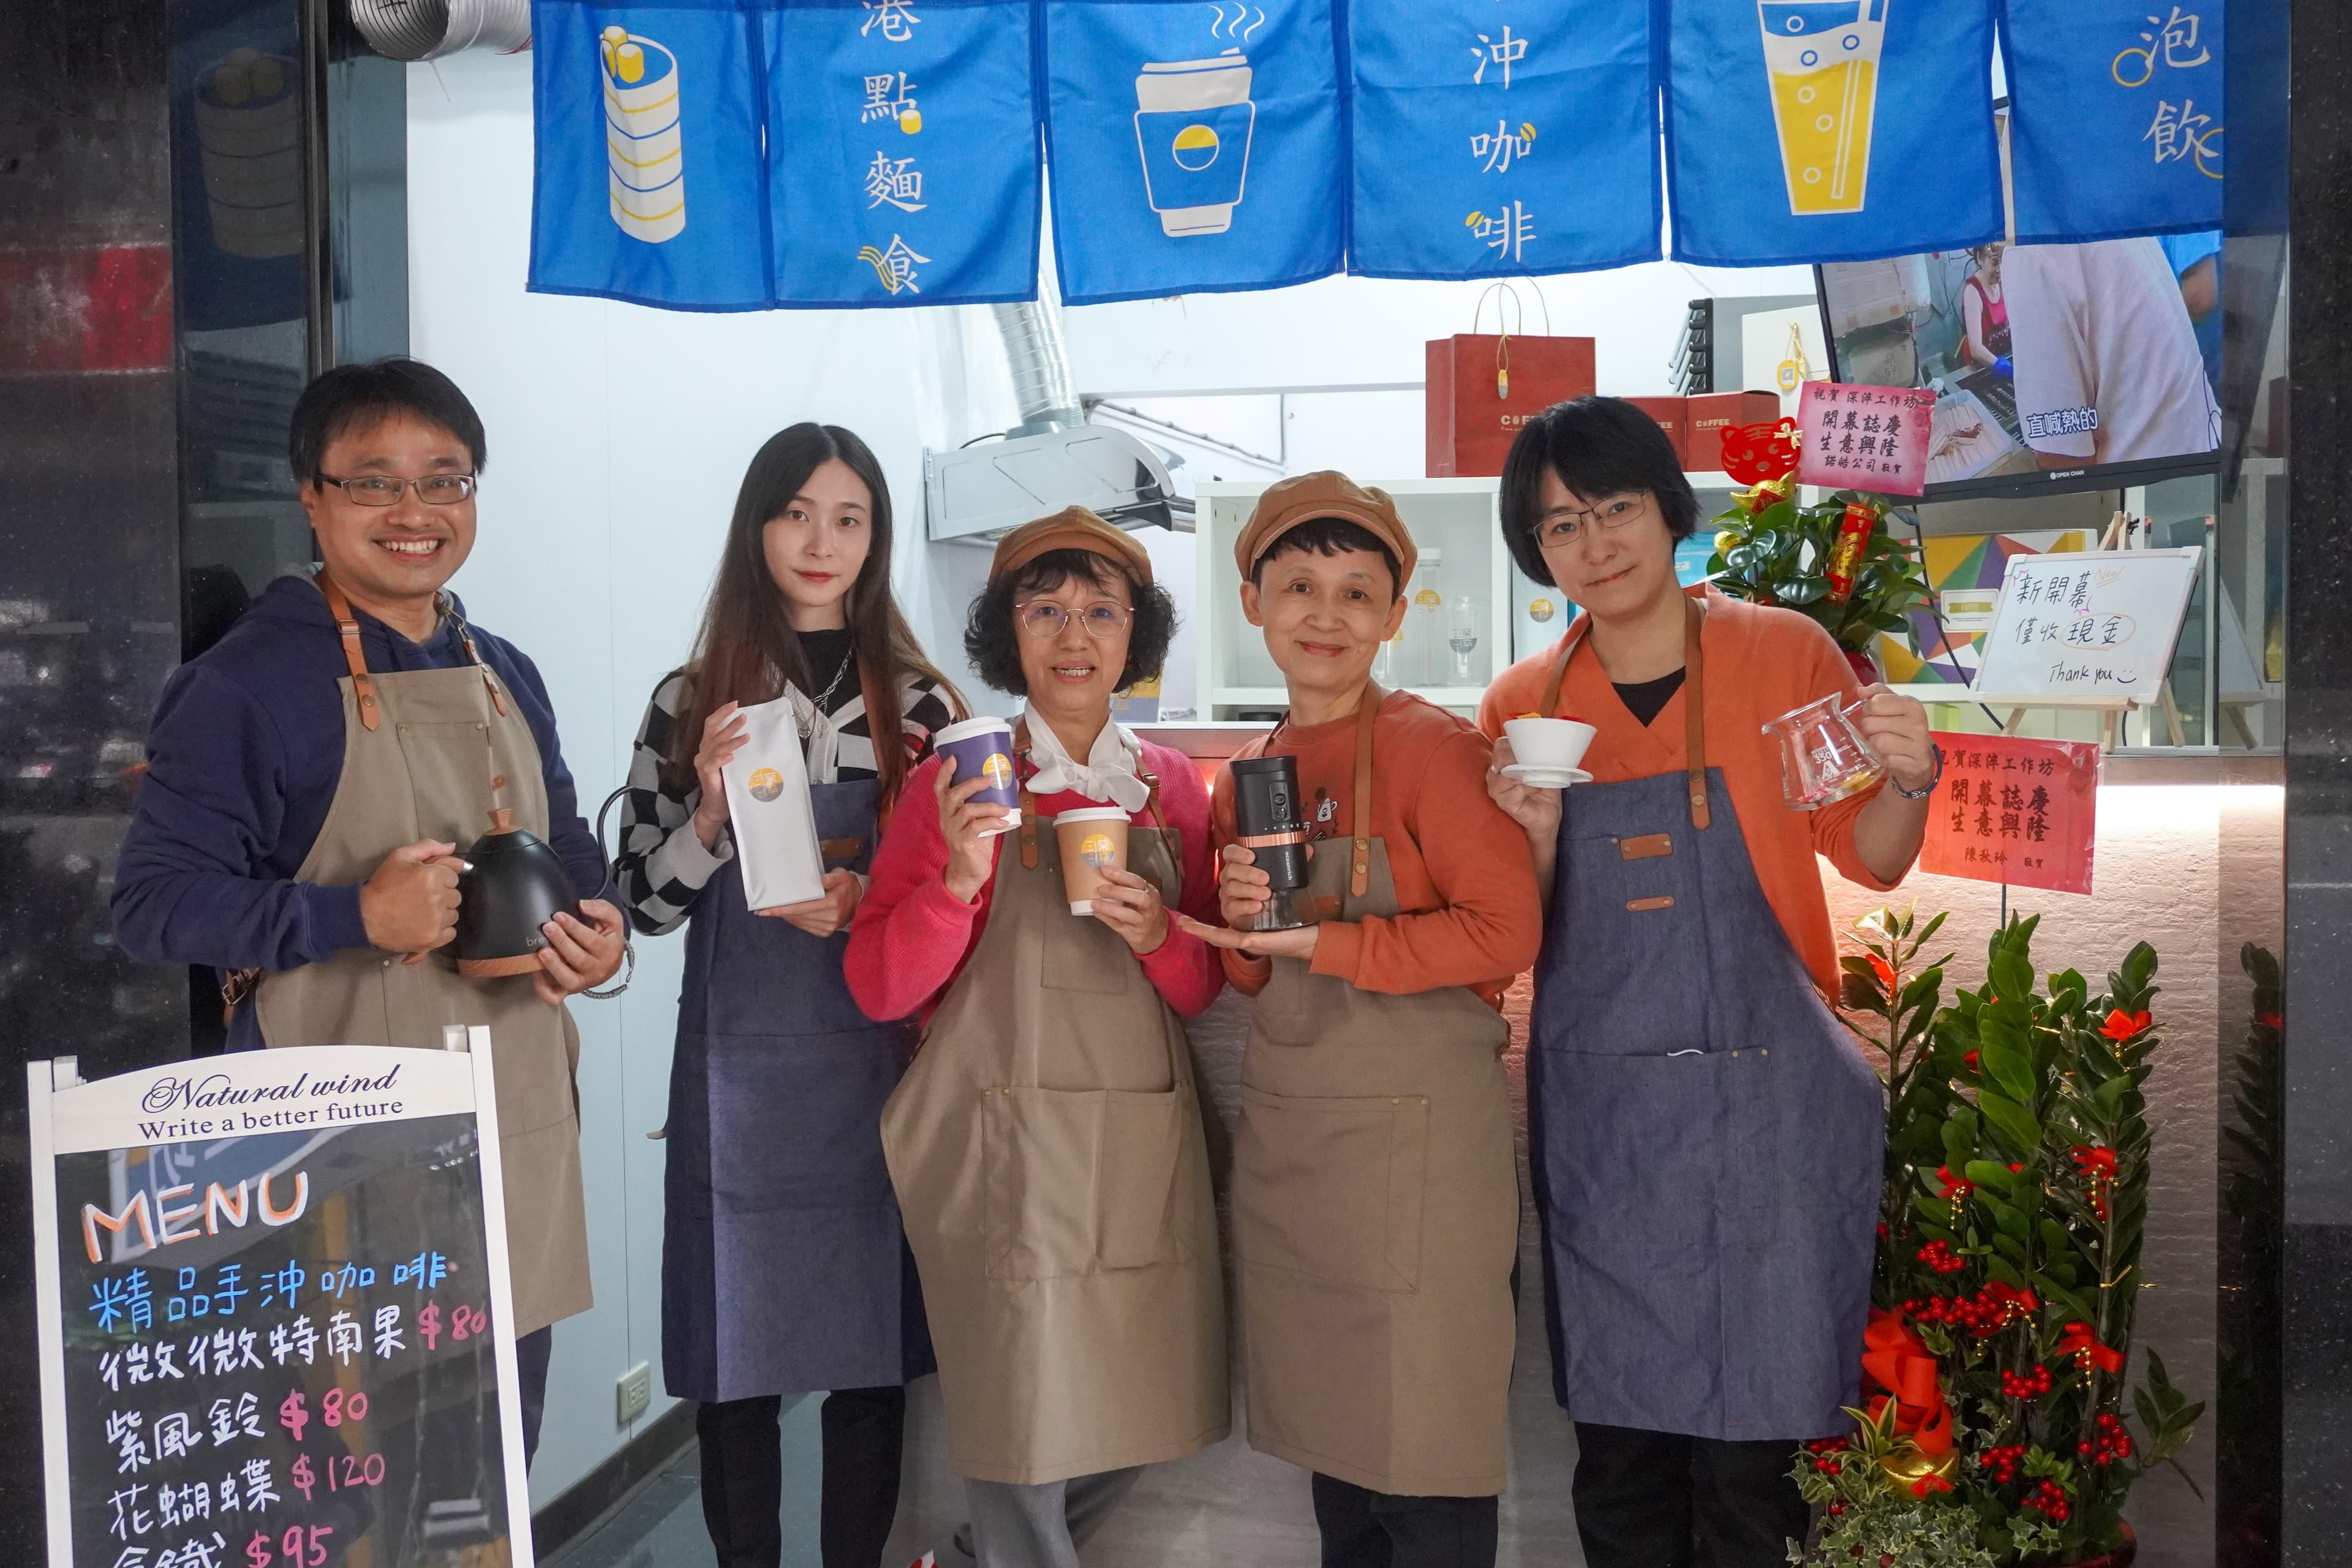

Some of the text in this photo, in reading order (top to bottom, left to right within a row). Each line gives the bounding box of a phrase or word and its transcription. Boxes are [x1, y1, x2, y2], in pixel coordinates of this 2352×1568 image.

[2140, 6, 2221, 163] 泡飲
[861, 0, 932, 295] 港點麵食
[1469, 0, 1537, 263] 沖咖啡
[1822, 410, 1901, 437] 開幕誌慶
[2027, 407, 2098, 438] 直喊熱的
[1820, 431, 1899, 457] 生意興隆
[2016, 570, 2092, 608] 新開幕
[2015, 615, 2122, 645] 僅收現金
[2049, 661, 2113, 684] Thank you
[1950, 778, 2051, 816] 開幕誌慶
[1950, 806, 2051, 843] 生意興隆
[141, 1063, 401, 1114] Natural wind
[137, 1099, 404, 1140] Write a better future
[81, 1170, 310, 1264] MENU
[88, 1251, 448, 1335] 精品手沖咖啡
[105, 1391, 266, 1474] 紫風鈴
[107, 1458, 281, 1541] 花蝴蝶
